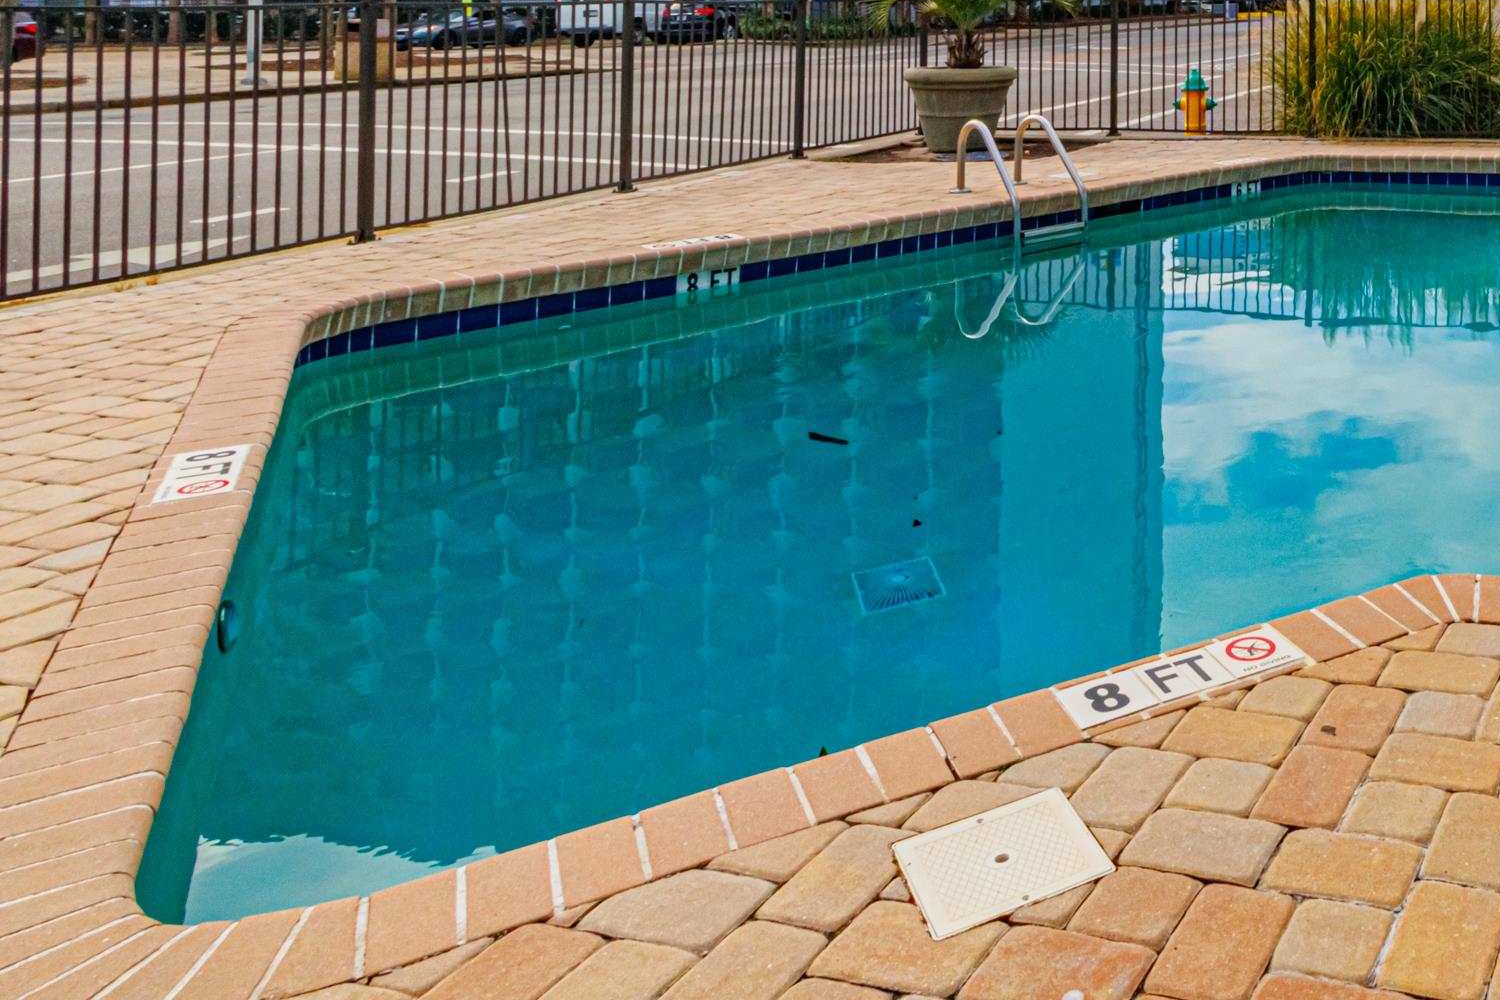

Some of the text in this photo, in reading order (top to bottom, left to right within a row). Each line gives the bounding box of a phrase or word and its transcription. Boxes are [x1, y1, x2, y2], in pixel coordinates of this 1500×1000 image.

[687, 267, 738, 291] 8 FT
[176, 450, 236, 480] 8 FT
[1084, 654, 1212, 712] 8 FT
